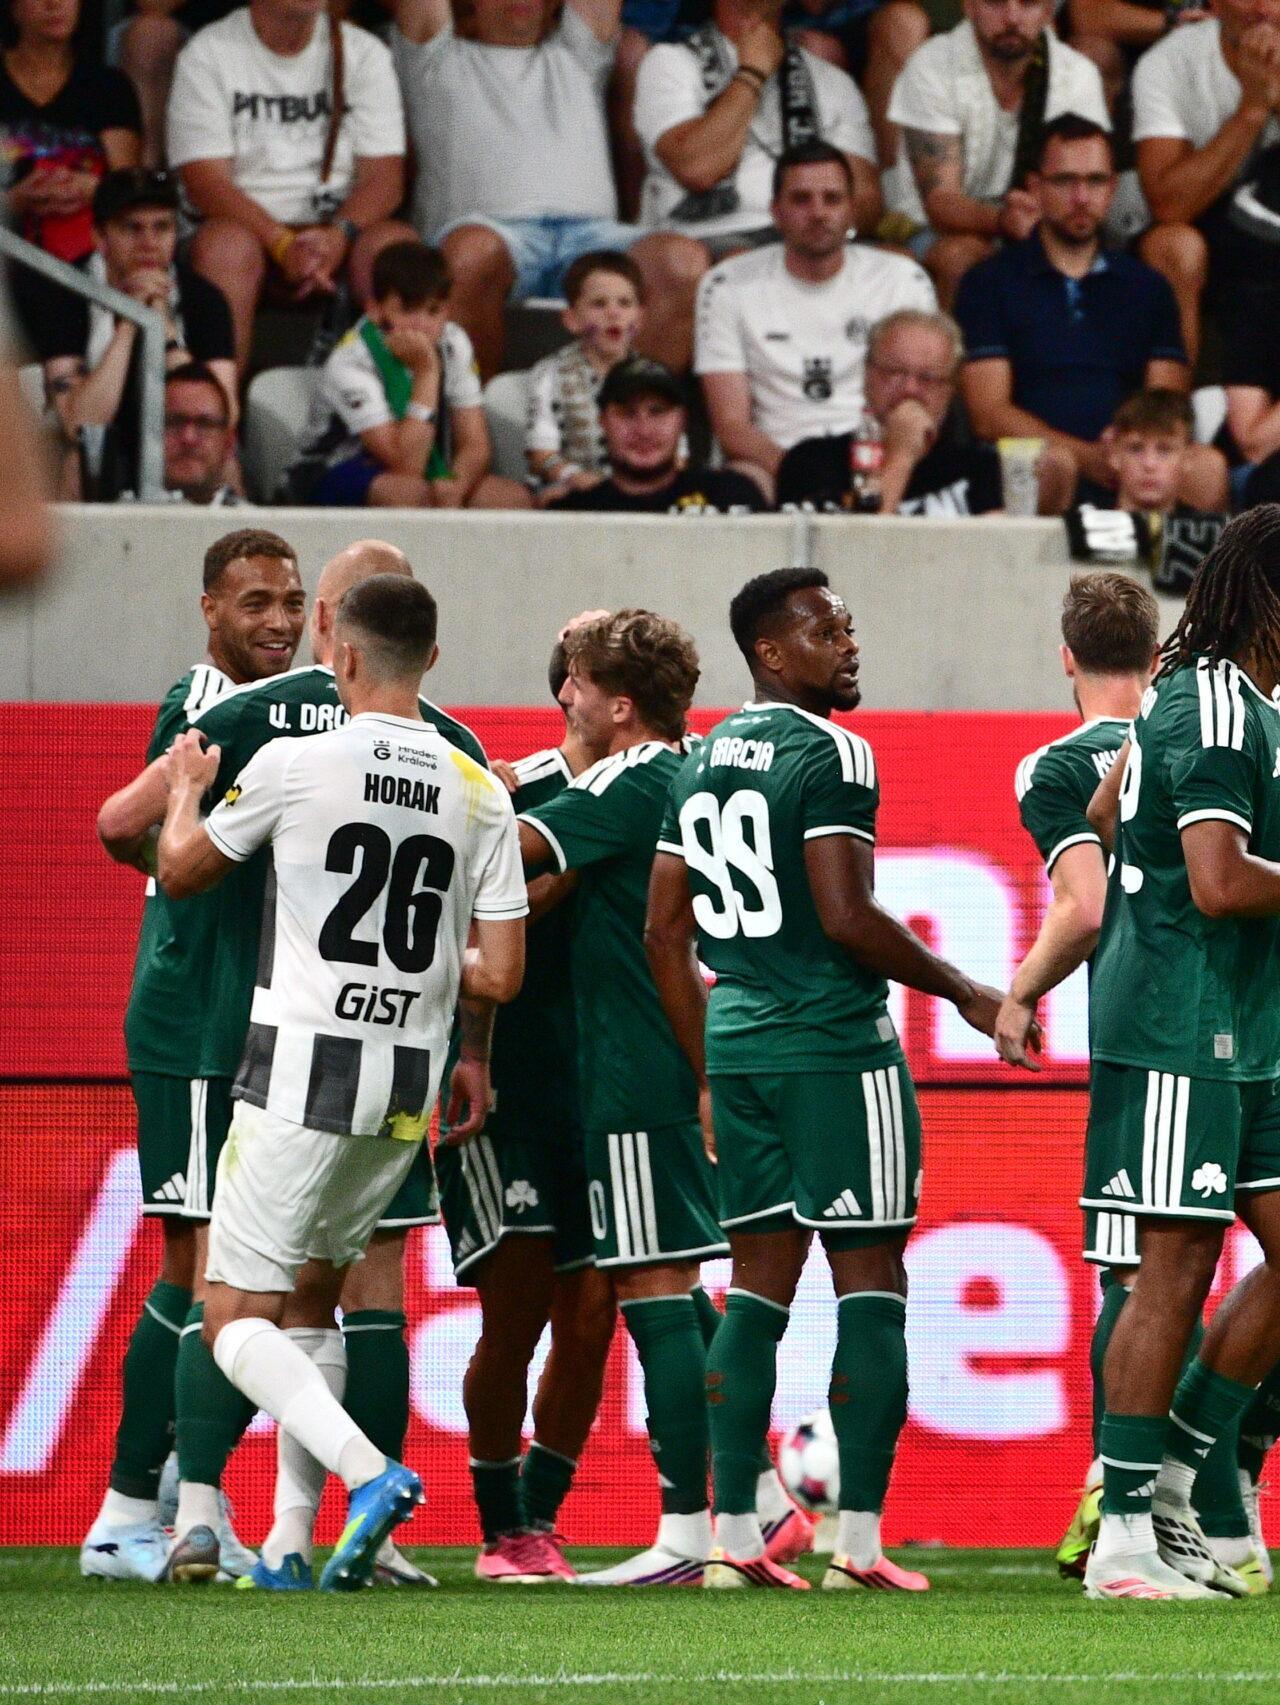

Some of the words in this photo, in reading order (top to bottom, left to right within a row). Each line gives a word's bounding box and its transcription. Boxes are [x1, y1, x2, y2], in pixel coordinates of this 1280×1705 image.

[363, 772, 441, 815] HORÁK
[679, 788, 783, 940] 99
[318, 821, 456, 974] 26
